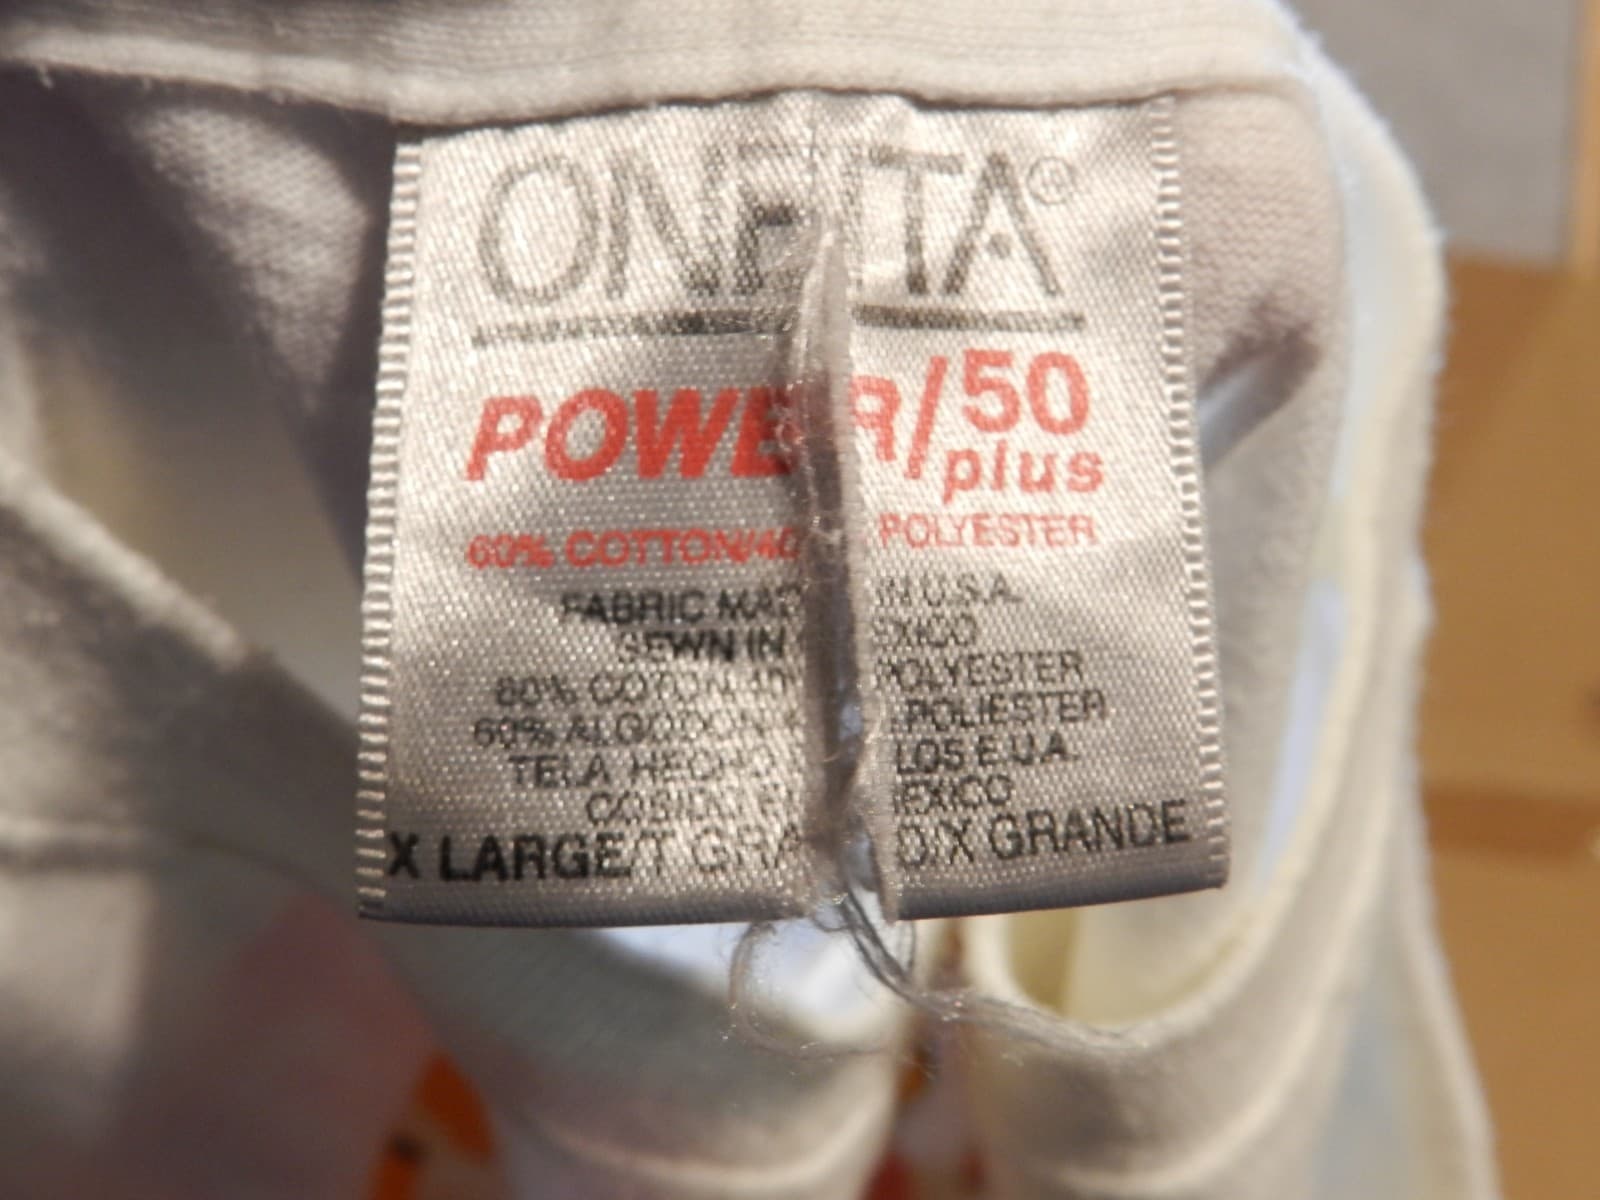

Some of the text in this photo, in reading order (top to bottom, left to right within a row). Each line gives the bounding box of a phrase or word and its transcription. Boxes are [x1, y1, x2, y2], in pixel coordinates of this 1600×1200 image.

[942, 438, 1104, 505] plus
[466, 534, 555, 569] 60%
[878, 512, 1095, 550] POLYESTER
[560, 589, 707, 625] FABRIC
[617, 613, 977, 662] SEWN IN EXICO
[472, 714, 556, 749] 60%
[905, 689, 1107, 732] POLIESTER
[509, 752, 613, 790] TELA
[896, 739, 966, 775] LOS
[388, 832, 420, 879] X
[989, 799, 1190, 860] GRANDE
